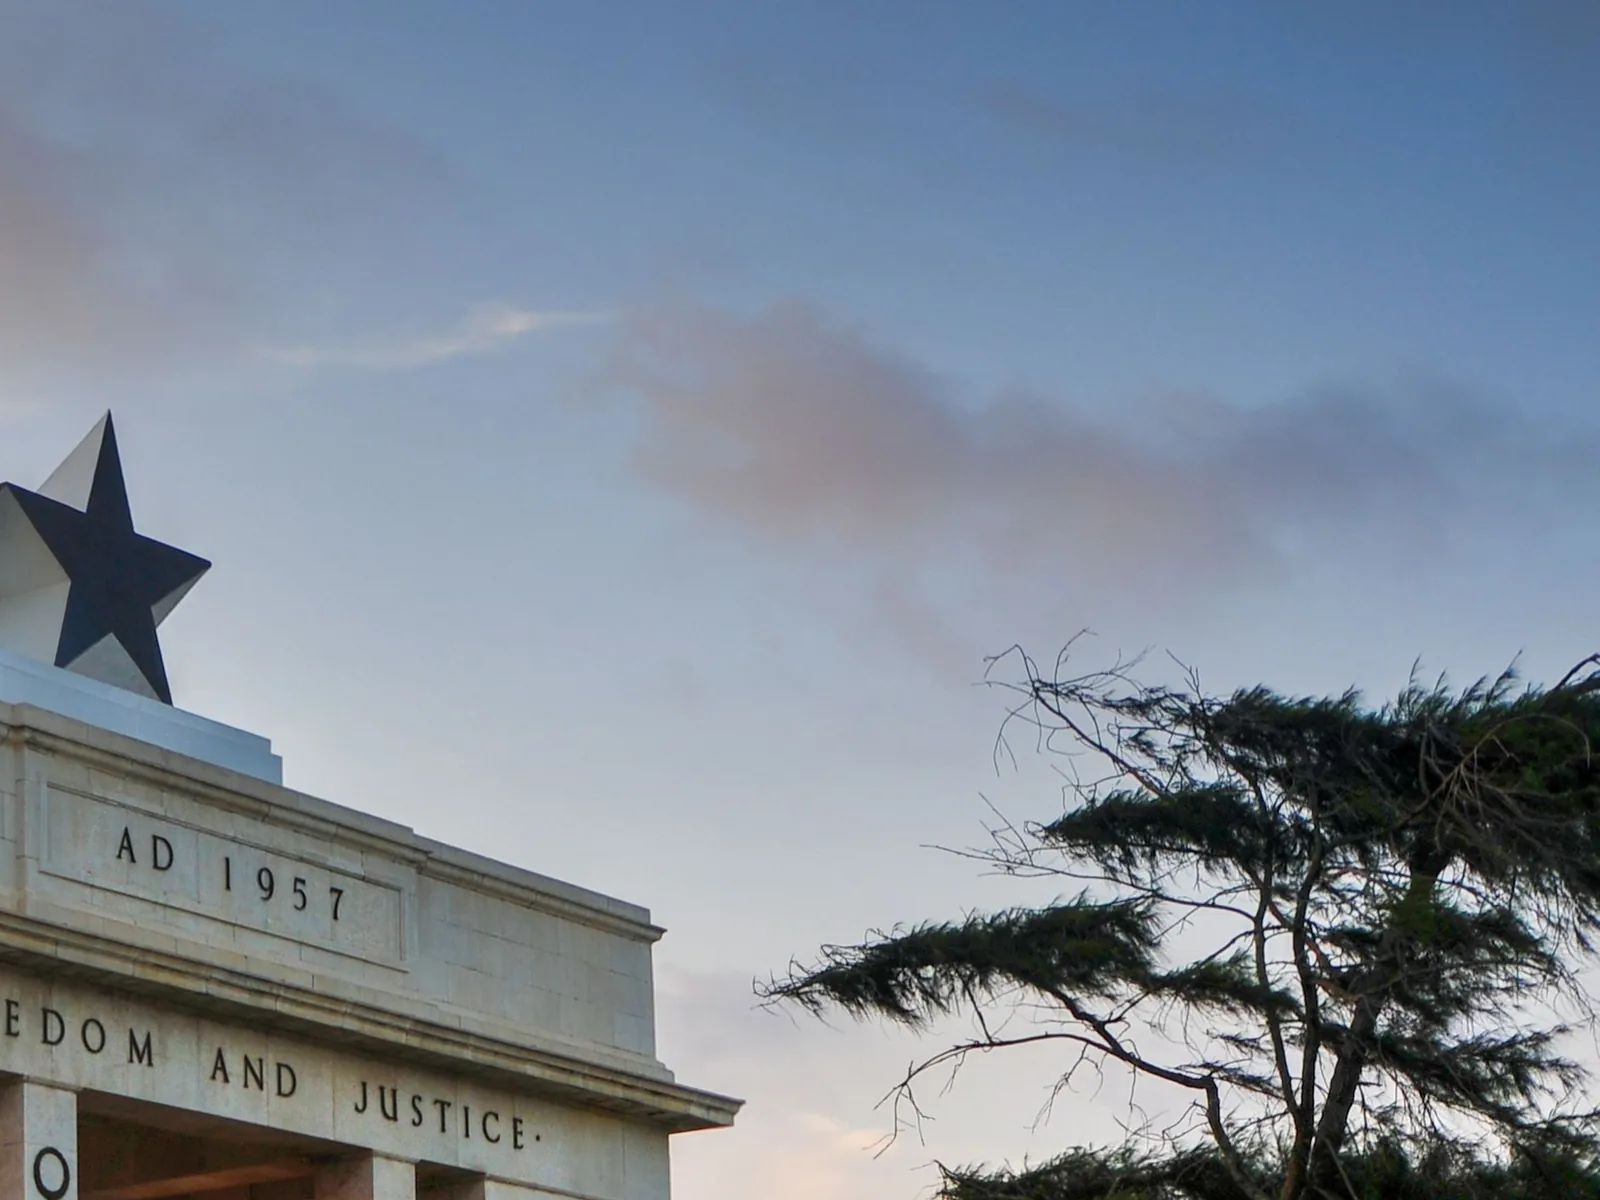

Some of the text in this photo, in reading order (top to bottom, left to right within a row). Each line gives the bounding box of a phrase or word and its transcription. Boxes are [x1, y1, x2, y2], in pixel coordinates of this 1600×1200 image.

[116, 825, 344, 921] AD 1957
[210, 1047, 297, 1098] AND
